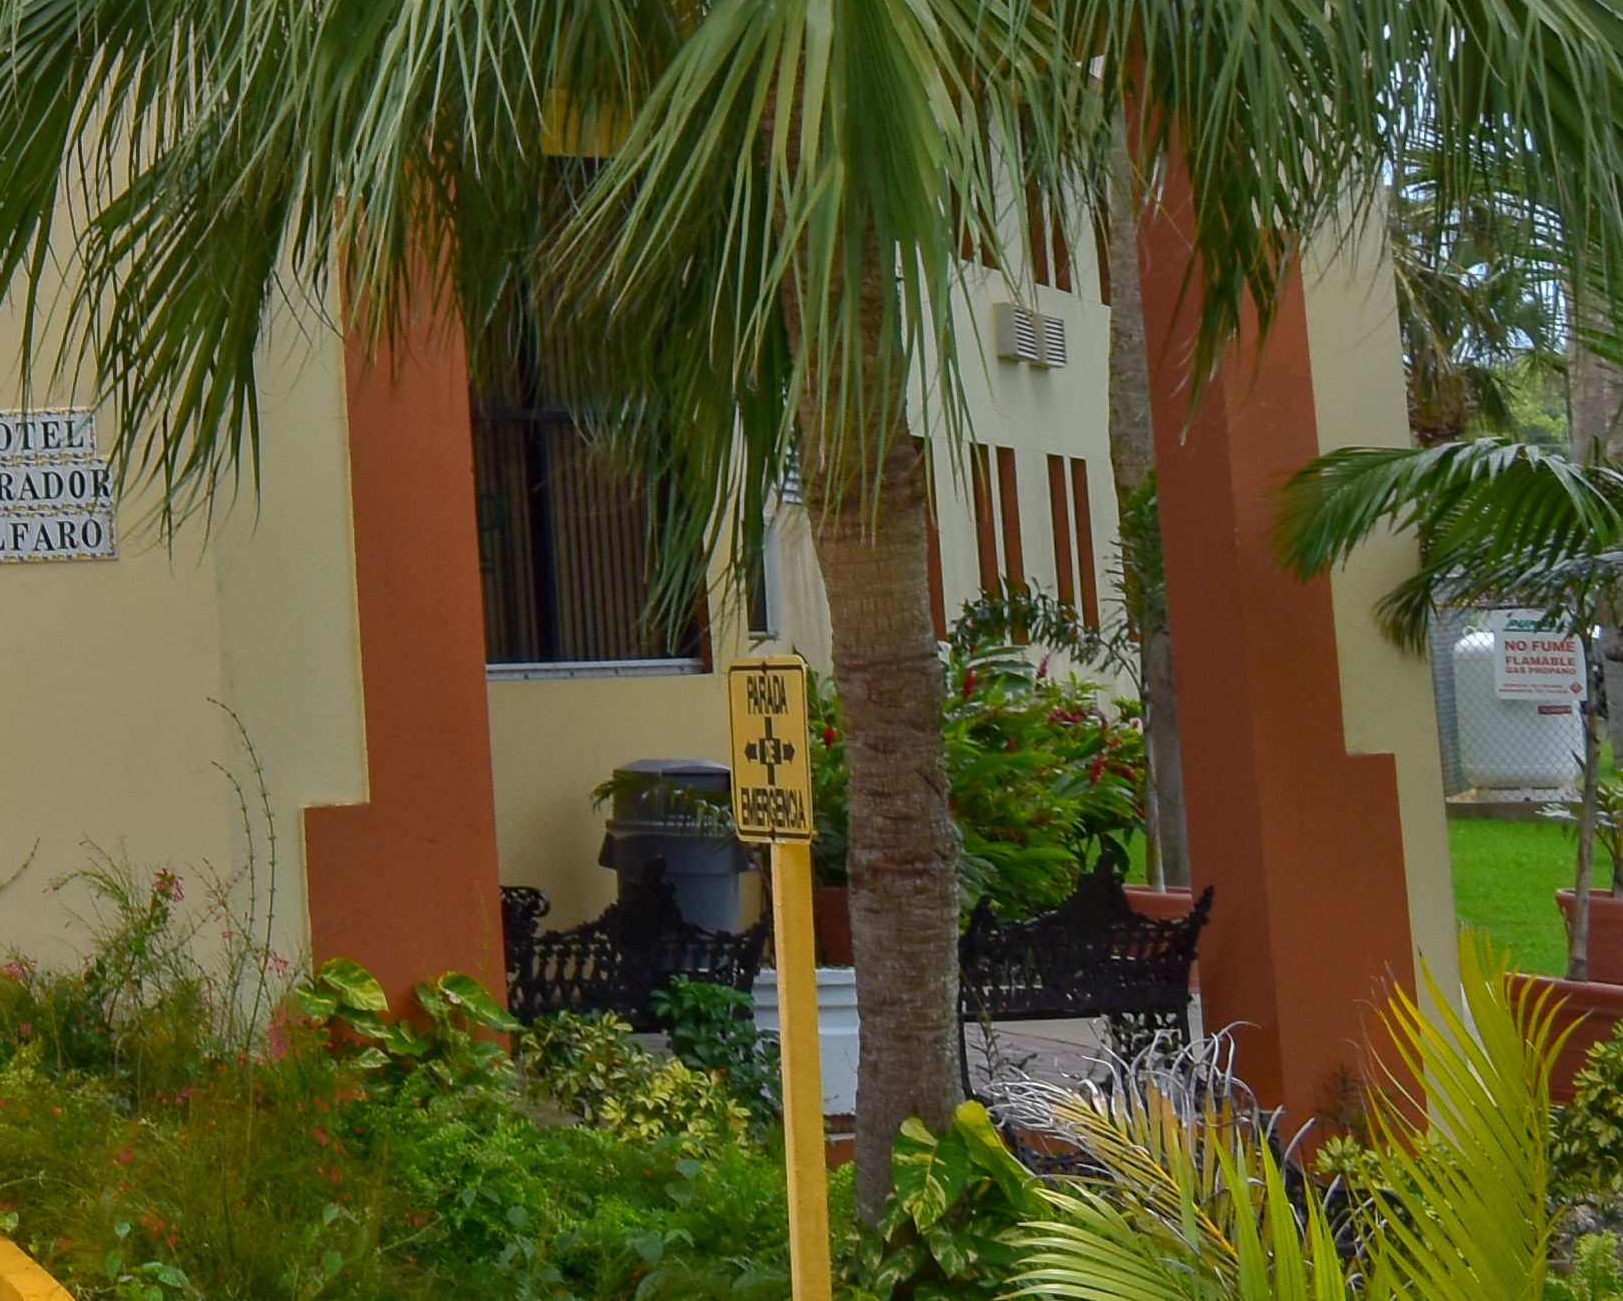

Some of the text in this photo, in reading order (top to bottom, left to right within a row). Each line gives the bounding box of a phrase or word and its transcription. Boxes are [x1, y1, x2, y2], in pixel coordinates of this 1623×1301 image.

[1504, 640, 1575, 652] NO FUME
[1505, 656, 1575, 666] FLAMABLE
[1505, 666, 1576, 675] GAS PROPANO
[747, 675, 788, 715] PARADA
[741, 787, 806, 829] EMERGENCIA
